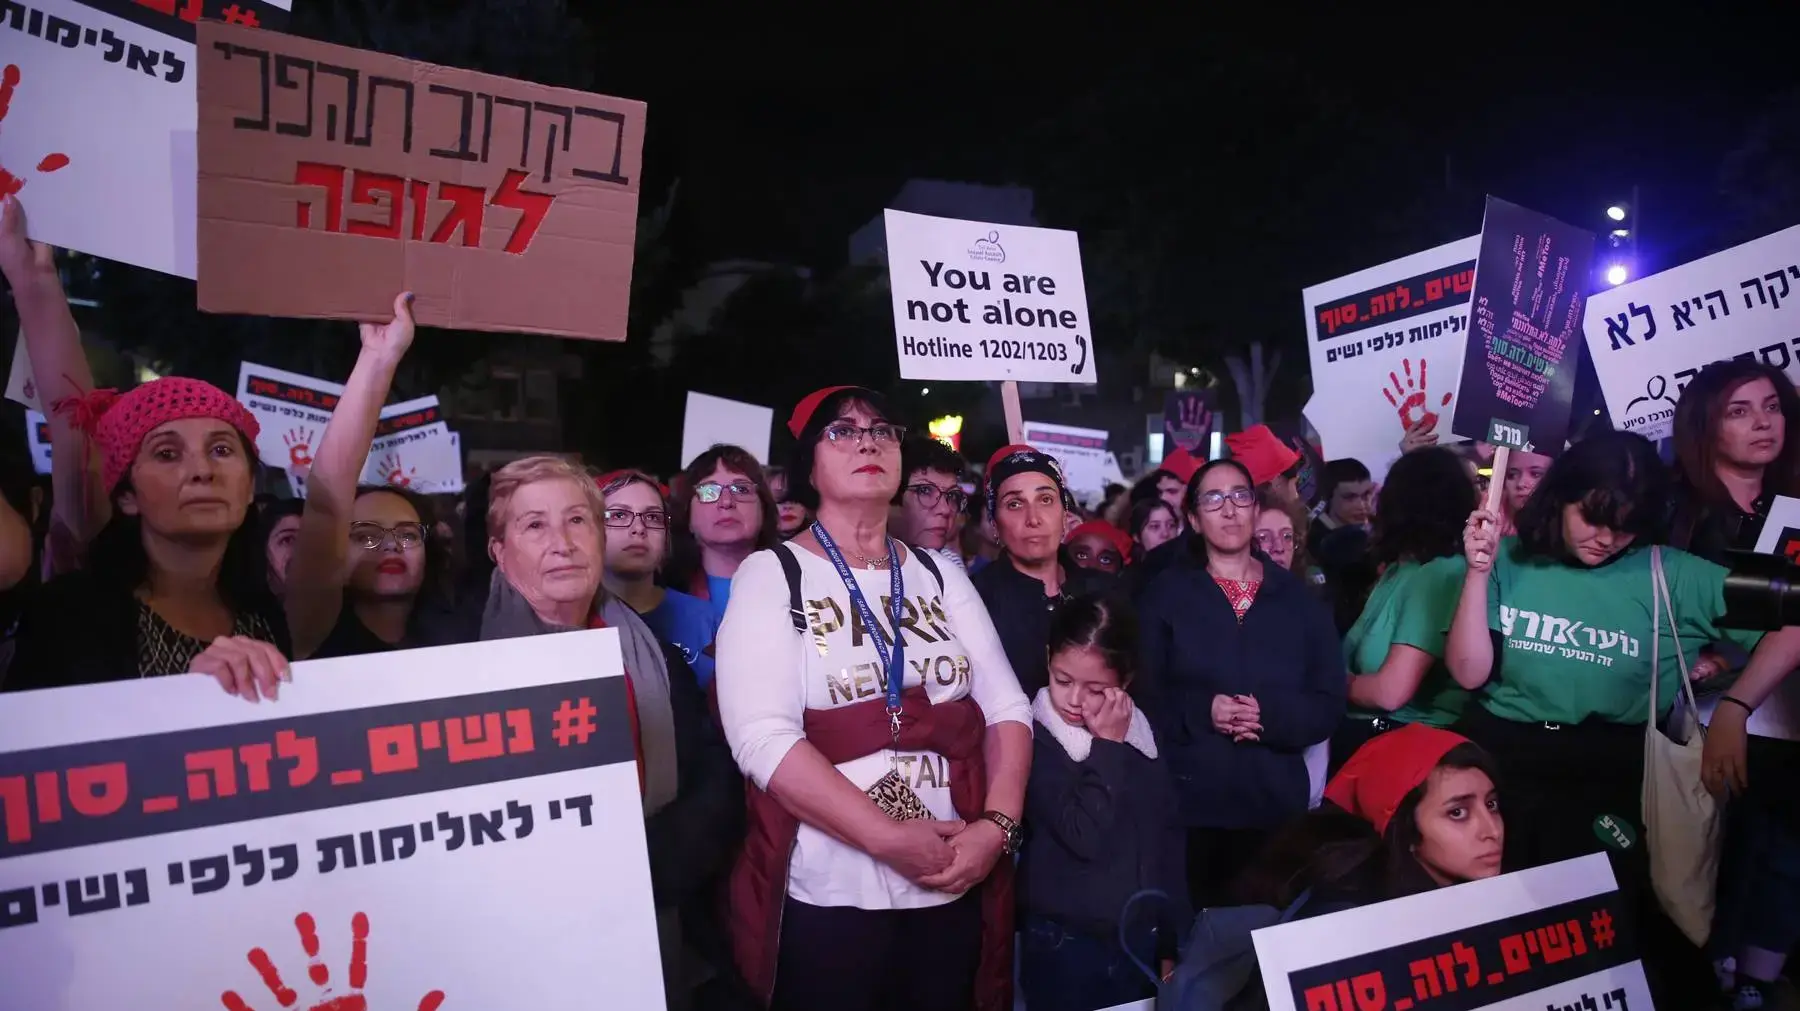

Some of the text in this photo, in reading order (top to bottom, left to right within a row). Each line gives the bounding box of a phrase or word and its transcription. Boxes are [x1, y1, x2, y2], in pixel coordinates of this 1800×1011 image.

[0, 1, 186, 84] לאלימות
[213, 41, 629, 185] בקרוב תהפכי
[295, 160, 558, 256] לגופה
[920, 260, 1056, 296] You are
[907, 299, 1077, 329] not alone
[1319, 269, 1474, 335] שים_לזה_סוף
[1670, 289, 1730, 331] היא
[1367, 331, 1404, 352] כלפי
[1604, 302, 1657, 351] לא
[903, 336, 1068, 361] Hotline 1202/1203
[1326, 342, 1364, 363] נשים
[1623, 416, 1646, 430] סיוע
[1647, 408, 1674, 422] מרכז
[1493, 423, 1521, 446] מרצ
[857, 599, 887, 654] ISRAEL AEROSPACE
[1500, 604, 1571, 645] מרצ
[909, 655, 970, 686] YOR
[1558, 645, 1595, 663] הנוער
[1596, 654, 1614, 668] זה
[1599, 815, 1631, 849] מרצ
[0, 794, 594, 929] די לאלימות כלפי נשים
